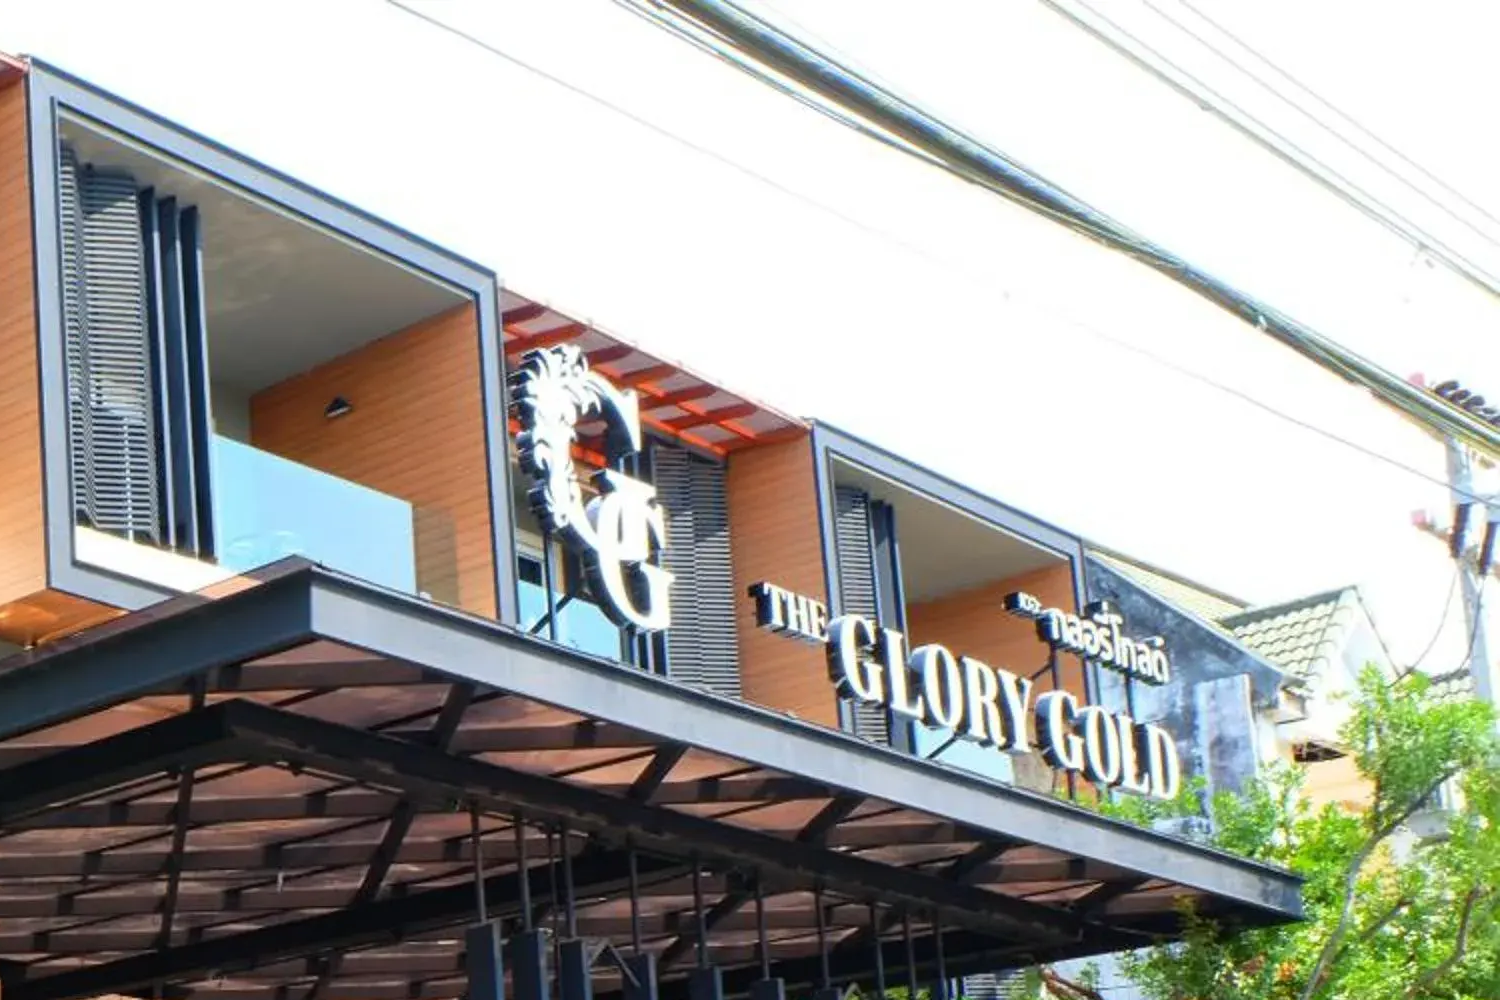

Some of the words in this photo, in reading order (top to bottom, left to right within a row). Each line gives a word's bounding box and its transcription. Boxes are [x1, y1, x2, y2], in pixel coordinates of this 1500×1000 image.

[754, 582, 830, 643] THE
[830, 612, 1034, 756] GLORY
[1036, 688, 1180, 801] GOLD
